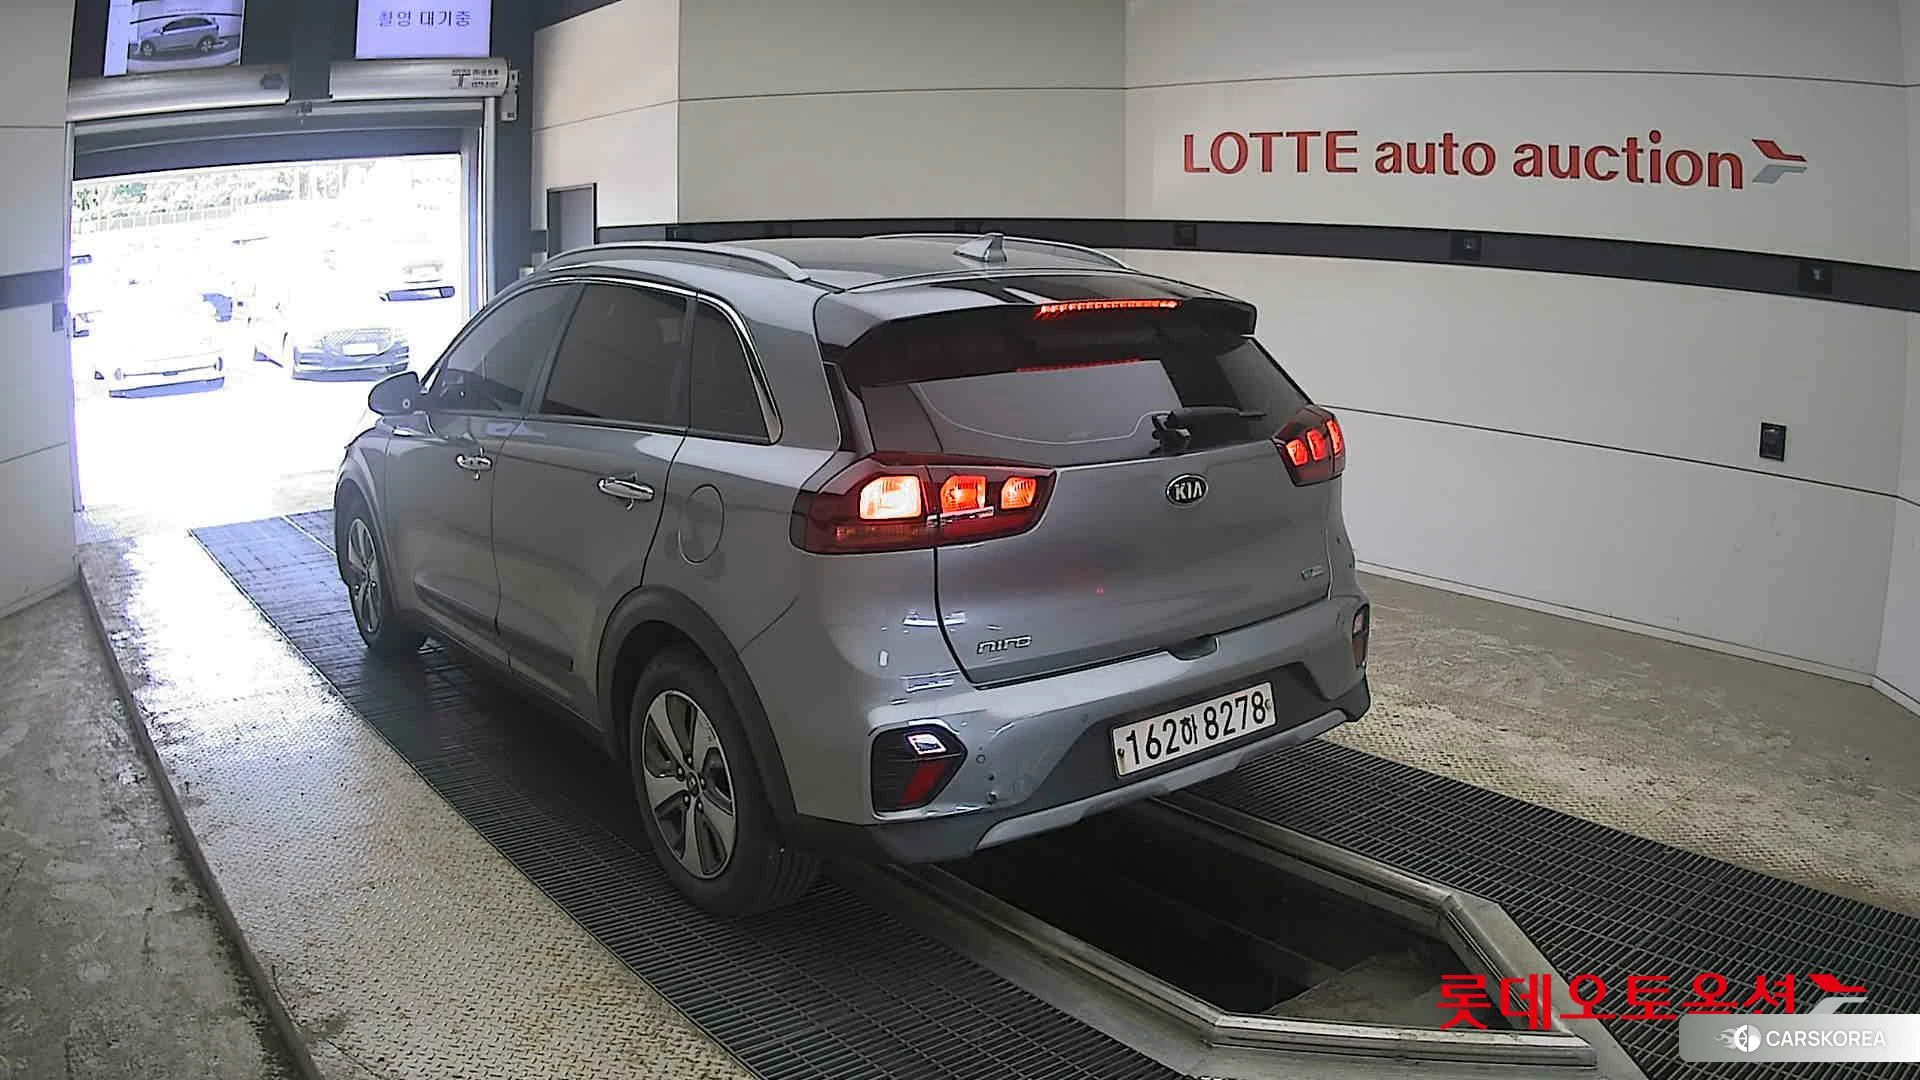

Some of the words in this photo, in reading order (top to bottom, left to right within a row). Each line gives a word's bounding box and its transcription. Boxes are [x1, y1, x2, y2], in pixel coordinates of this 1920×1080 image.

[420, 10, 471, 27] 대기중
[1184, 131, 1358, 174] LOTTE
[1375, 132, 1497, 177] auto
[1513, 129, 1744, 189] auction
[1173, 481, 1203, 500] KIA
[1126, 714, 1198, 764] 162하
[1203, 691, 1266, 740] 8278
